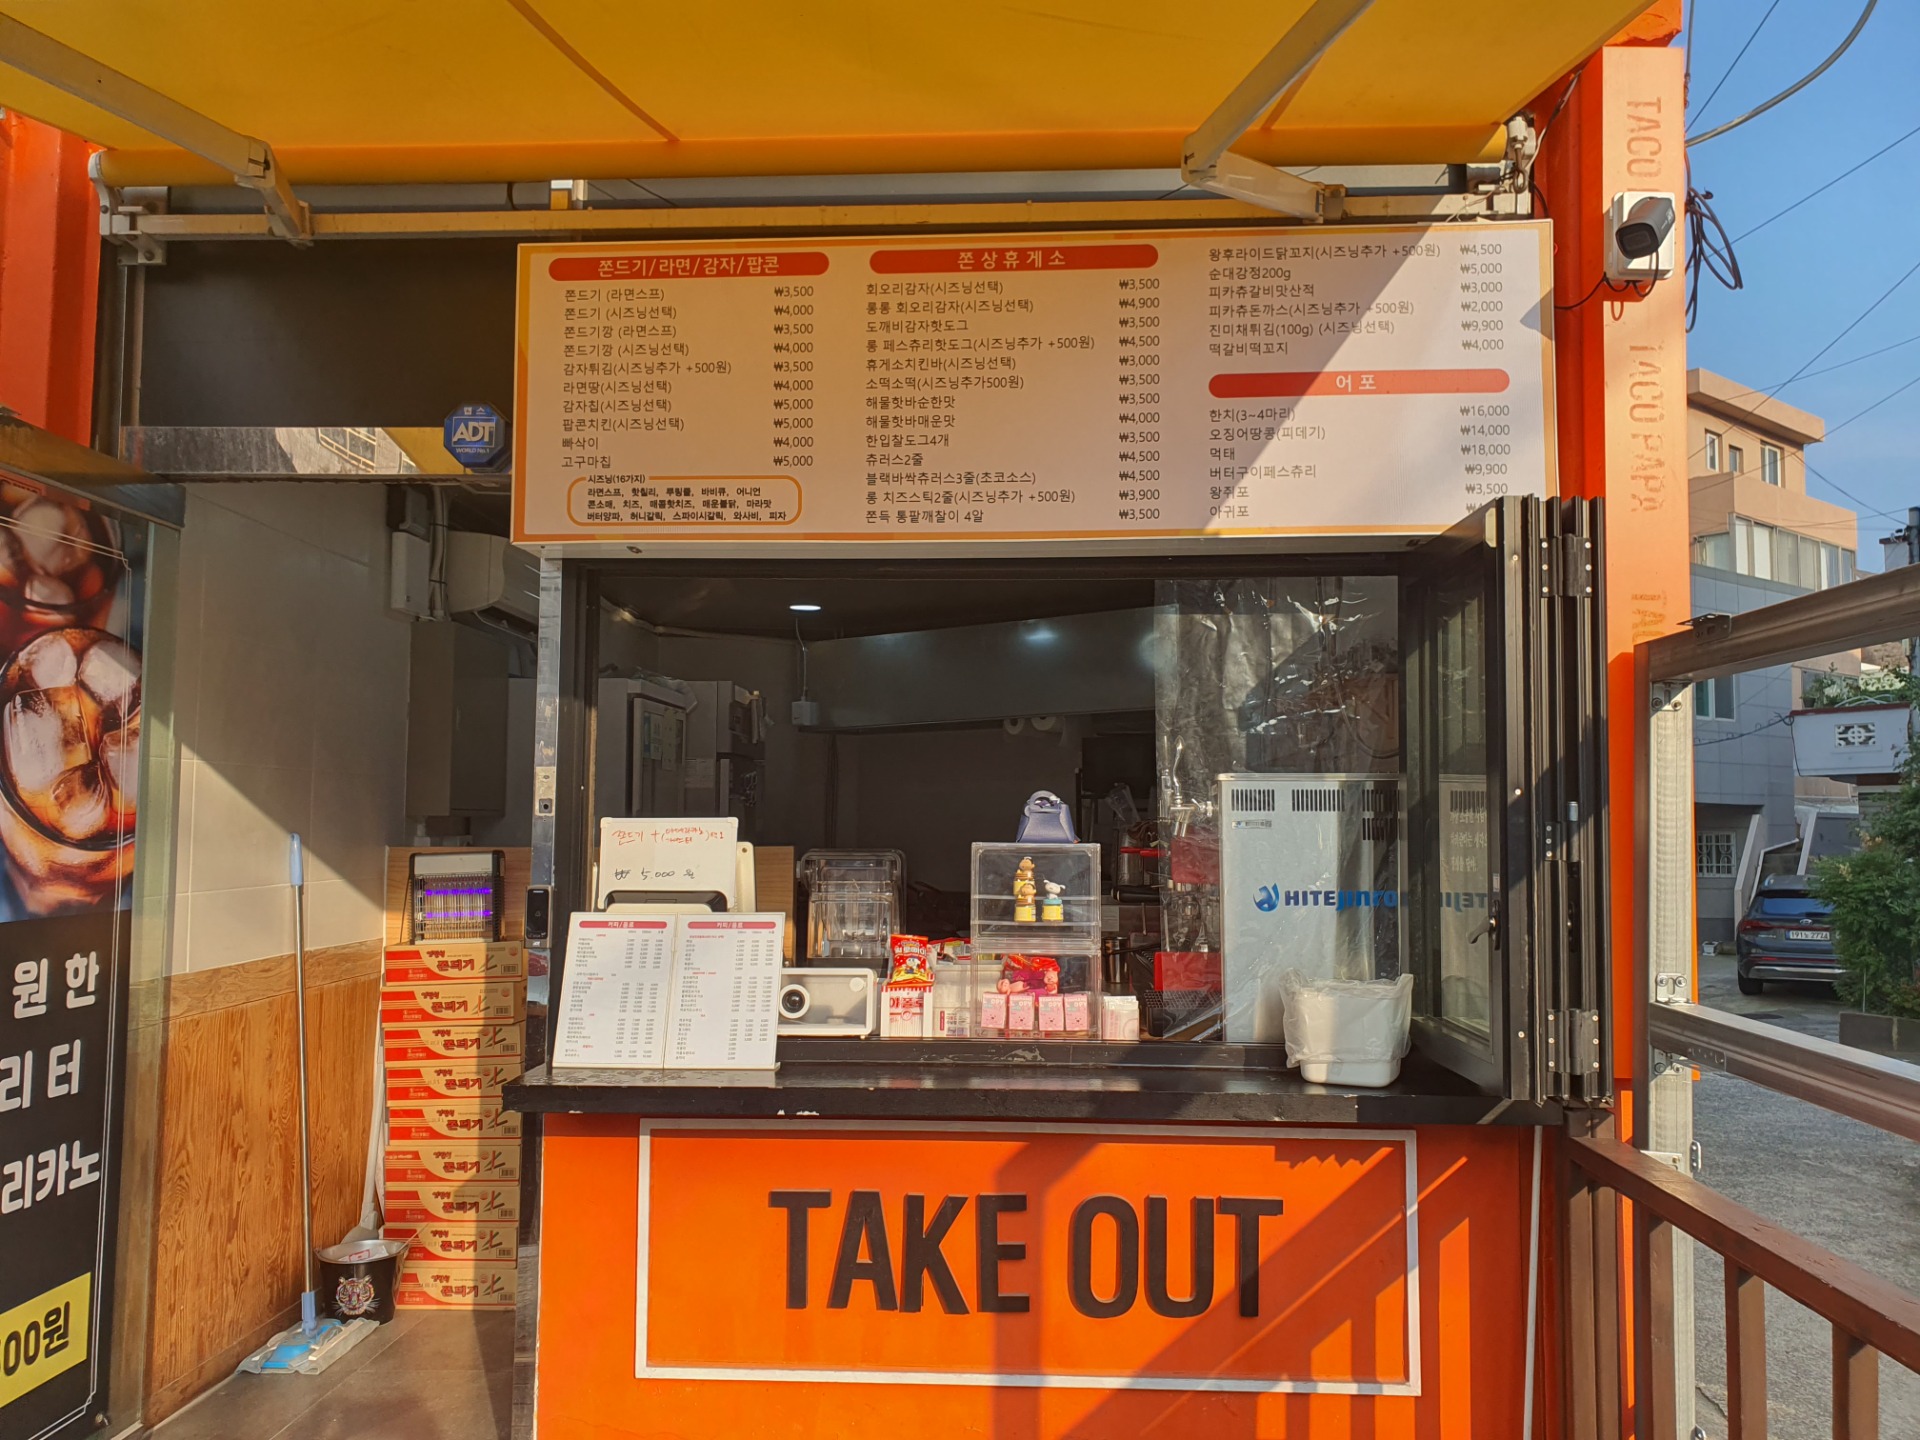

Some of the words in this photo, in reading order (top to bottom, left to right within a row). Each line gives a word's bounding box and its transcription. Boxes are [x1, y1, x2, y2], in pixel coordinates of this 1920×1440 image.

[1393, 243, 1440, 259] +500원)
[1460, 244, 1501, 255] ₩4,500
[598, 256, 780, 277] 쫀드기/라면/감자/팝콘
[1209, 267, 1290, 281] 순대강정200g
[1460, 263, 1502, 274] ₩5,000
[565, 290, 600, 302] 쫀드기
[607, 289, 664, 302] (라면스프)
[774, 286, 813, 297] ₩3,500
[867, 281, 1003, 296] 회오리감자(시즈닝선택)
[1119, 279, 1159, 289] ₩3,500
[1209, 284, 1313, 299] 피카츄갈비맛산적
[1461, 282, 1502, 293] ₩3,000
[565, 308, 600, 320] 쫀드기
[606, 306, 676, 320] (시즈닝선택)
[774, 305, 813, 316] ₩4,000
[866, 302, 891, 315] 롱롱
[896, 299, 1033, 314] 회오리감자(시즈닝선택)
[1119, 297, 1159, 308] ₩4,900
[1209, 302, 1362, 319] 피카츄돈까스(시즈닝추가
[1461, 301, 1503, 312] ₩2,000
[564, 326, 613, 339] 쫀드기깡
[618, 325, 676, 338] (라면스프)
[774, 324, 813, 335] ₩3,500
[866, 320, 968, 333] 도깨비감자핫도그
[1119, 316, 1159, 328] ₩3,500
[1210, 323, 1313, 337] 진미채튀김(100g)
[1319, 319, 1394, 336] (시즈닝선택)
[1461, 320, 1503, 331] ₩9,900
[564, 344, 613, 357] 쫀드기깡
[618, 343, 689, 357] (시즈닝선택)
[774, 342, 813, 353] ₩4,000
[866, 340, 878, 353] 롱
[1048, 336, 1094, 349] +500원)
[1119, 336, 1159, 346] ₩4,500
[1209, 342, 1287, 356] 떡갈비떡꼬지
[1462, 339, 1504, 351] ₩4,000
[564, 362, 681, 376] 감자튀김(시즈닝추가
[686, 361, 731, 373] +500원)
[774, 361, 813, 372] ₩3,500
[866, 357, 1015, 371] 휴게소치킨바(시즈닝선택)
[1119, 355, 1159, 366] ₩3,000
[564, 380, 671, 394] 라면땅(시즈닝선택)
[774, 380, 813, 391] ₩4,000
[866, 376, 1023, 391] 소떡소떡(시즈닝추가500원)
[1119, 374, 1160, 385] ₩3,500
[563, 399, 671, 413] 감자칩(시즈닝선택)
[774, 399, 813, 409] ₩5,000
[866, 396, 955, 409] 해물핫바순한맛
[1119, 393, 1160, 404] ₩3,500
[866, 415, 955, 428] 해물핫바매운맛
[1119, 412, 1160, 423] ₩4,000
[1210, 408, 1294, 423] 한치(3~4마리)
[1460, 405, 1509, 416] ₩16,000
[452, 422, 495, 442] ADT
[563, 418, 684, 431] 팝콘치킨(시즈닝선택)
[774, 418, 813, 428] ₩5,000
[866, 434, 948, 447] 한입찰도그4개
[1119, 432, 1160, 442] ₩3,500
[1209, 426, 1325, 441] 오징어땅콩(피데기)
[1460, 425, 1510, 436] ₩14,000
[562, 437, 598, 450] 빠삭이
[773, 437, 813, 447] ₩4,000
[866, 453, 923, 466] 츄러스2줄
[1119, 451, 1160, 461] ₩4,500
[1210, 448, 1234, 460] 먹태
[1461, 444, 1510, 455] ₩18,000
[562, 456, 610, 468] 고구마칩
[773, 456, 813, 466] ₩5,000
[588, 475, 645, 484] 시즈닝(16가지)
[1119, 470, 1160, 481] ₩4,500
[1210, 465, 1315, 480] 버터구이페스츄리
[1465, 464, 1507, 474] ₩9,900
[737, 487, 760, 496] 어니언
[866, 492, 877, 504] 롱
[883, 490, 1023, 504] 치즈스틱2줄(시즈닝추가
[1029, 490, 1075, 503] +500원)
[1119, 489, 1160, 500] ₩3,900
[1210, 486, 1248, 499] 왕쥐포
[1466, 483, 1508, 496] ₩3,500
[866, 511, 890, 523] 쫀득
[964, 510, 983, 522] 4알
[1119, 509, 1160, 519] ₩3,500
[1210, 503, 1249, 518] 아귀포
[1, 1140, 100, 1214] 리카노
[768, 1189, 1029, 1315] TAKE
[1068, 1195, 1284, 1319] OUT
